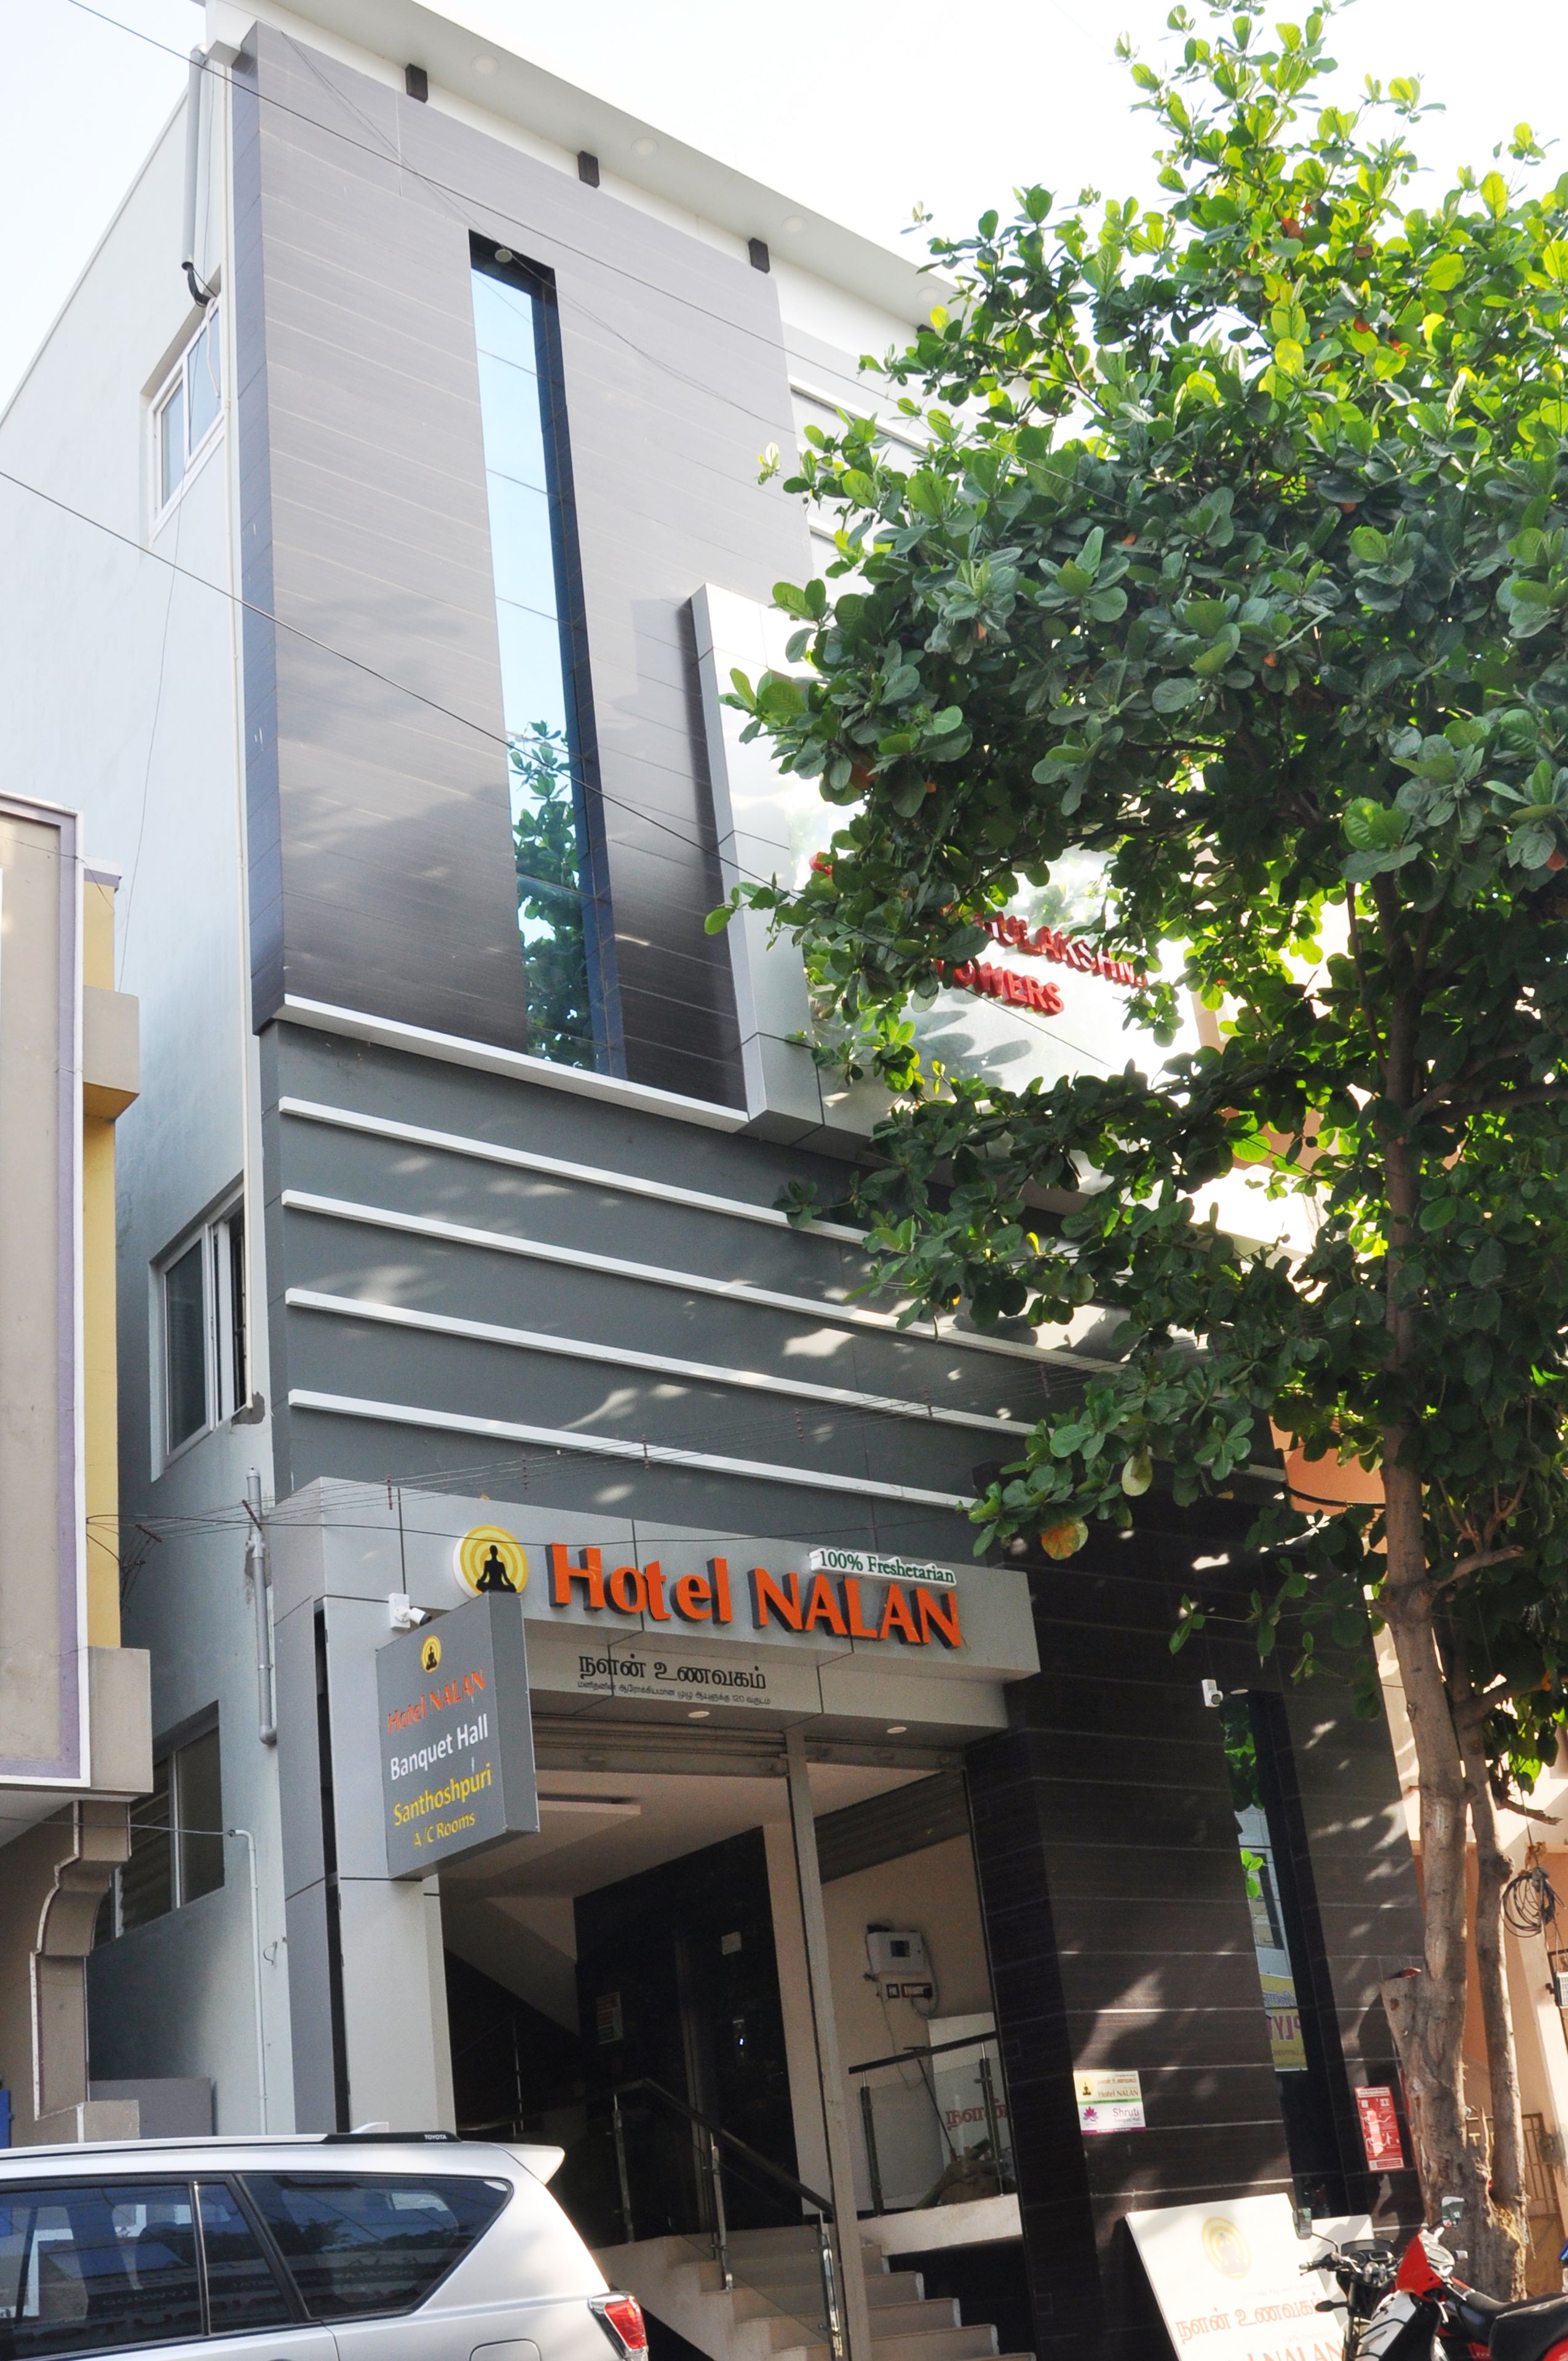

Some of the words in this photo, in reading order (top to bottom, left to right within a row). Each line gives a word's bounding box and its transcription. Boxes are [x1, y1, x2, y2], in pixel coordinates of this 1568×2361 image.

[548, 1541, 734, 1625] Hotel
[748, 1567, 962, 1649] NALAN
[820, 1551, 863, 1571] 100%
[868, 1556, 955, 1583] Freshetarian
[387, 1694, 427, 1734] Hotel
[430, 1667, 487, 1712] NALAN
[579, 1653, 646, 1679] நளன்
[654, 1661, 766, 1690] உணவகம்
[390, 1733, 453, 1781] Banquet
[457, 1713, 488, 1750] Hall
[394, 1762, 493, 1827] Santhoshpuri
[437, 1811, 475, 1840] Rooms
